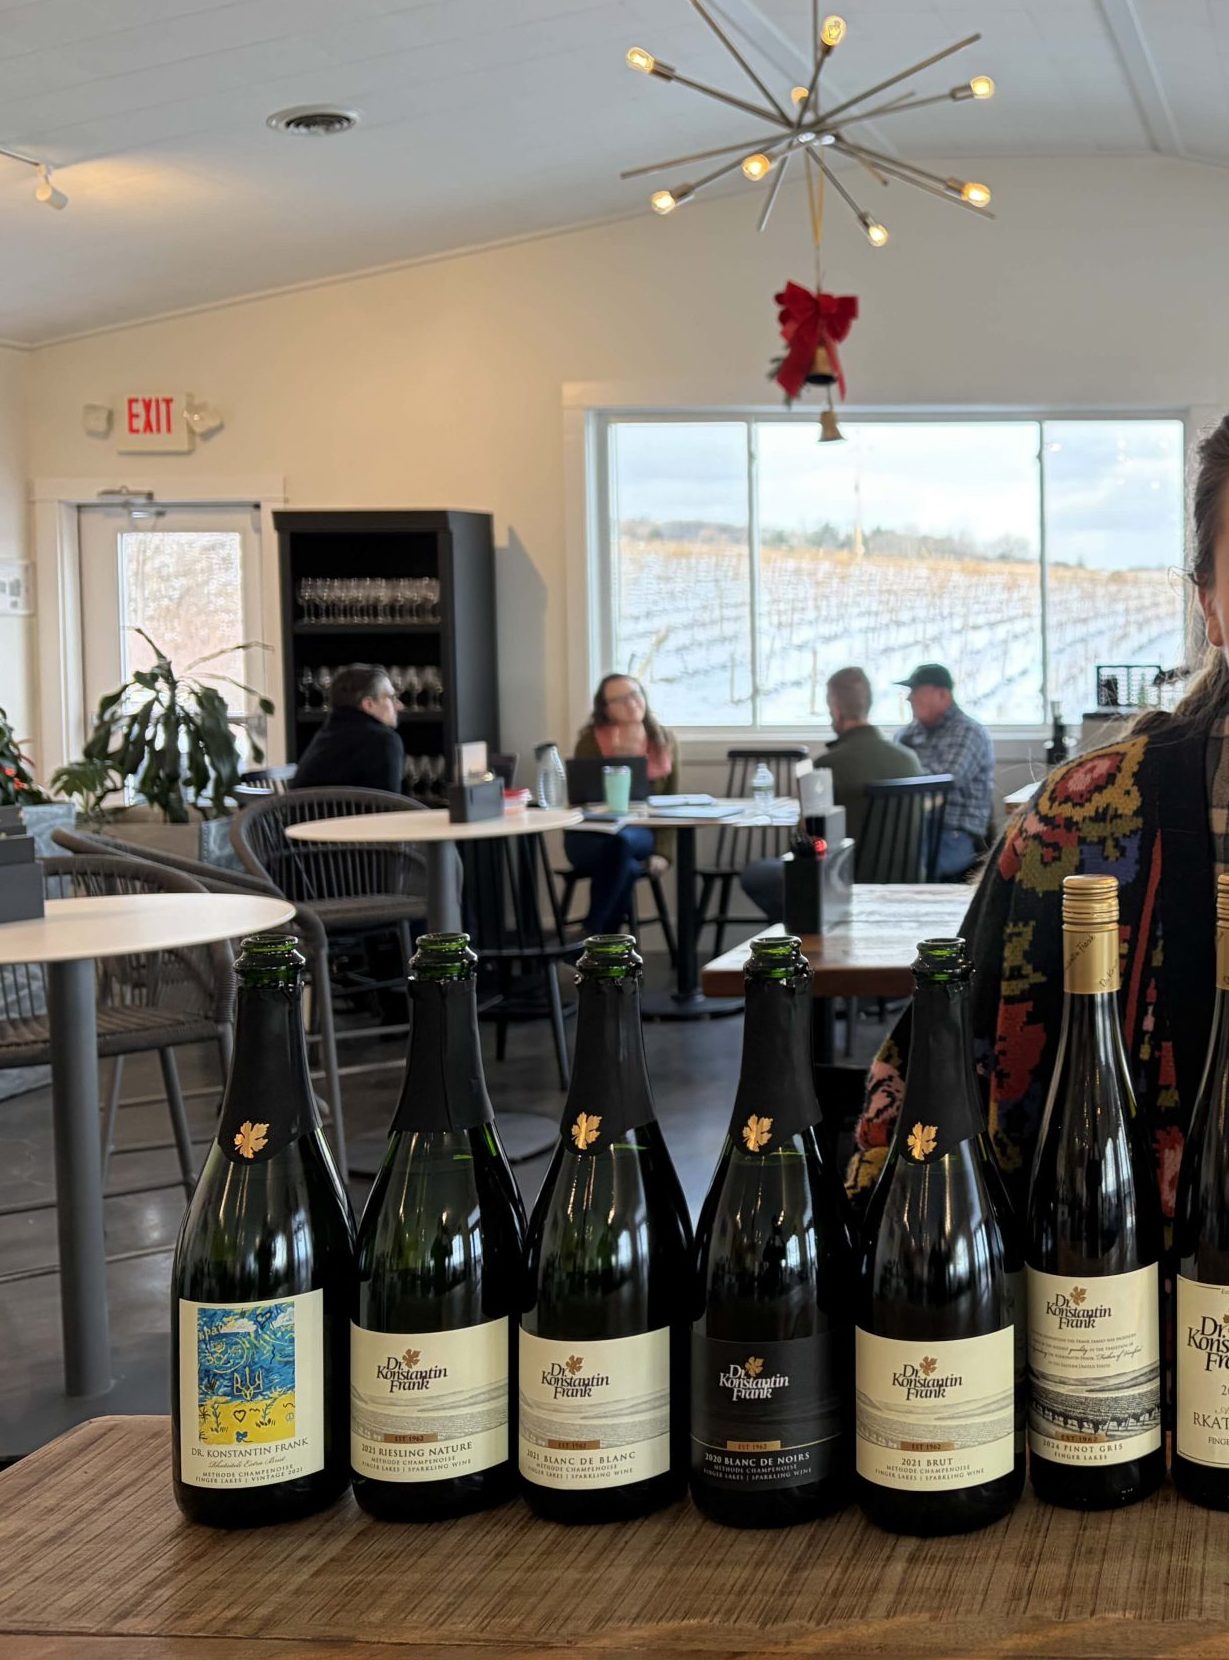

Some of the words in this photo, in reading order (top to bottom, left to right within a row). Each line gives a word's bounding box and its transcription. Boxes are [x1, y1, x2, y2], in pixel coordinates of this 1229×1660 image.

[127, 397, 173, 434] EXIT
[1055, 1293, 1071, 1308] Dr.
[1046, 1301, 1112, 1318] Konstantin
[1058, 1317, 1096, 1330] Frank
[1200, 1315, 1225, 1338] Dr.
[386, 1357, 403, 1370] Dr.
[550, 1362, 567, 1377] Dr.
[376, 1365, 448, 1380] Konstantin
[541, 1371, 610, 1387] Konstantin
[729, 1364, 747, 1379] Dr.
[903, 1364, 920, 1379] Dr.
[389, 1379, 430, 1393] Frank
[719, 1374, 790, 1389] Konstantin
[892, 1373, 963, 1389] Konstantin
[553, 1383, 593, 1400] Frank
[732, 1386, 772, 1402] Frank
[906, 1385, 946, 1401] Frank
[192, 1447, 205, 1456] DR.
[207, 1447, 272, 1458] KONSTANTIN
[275, 1438, 309, 1452] FRANK
[379, 1448, 425, 1458] RIESLING
[429, 1441, 473, 1456] NATURE
[1043, 1440, 1060, 1450] 2024
[1064, 1444, 1094, 1453] PINOT
[1099, 1443, 1123, 1452] GRIS
[402, 1455, 456, 1466] CHAMPENOISE
[544, 1454, 575, 1465] BLANC
[580, 1457, 594, 1465] DE
[599, 1451, 636, 1464] BLANC
[704, 1452, 722, 1464] 2020
[724, 1456, 757, 1467] BLANC
[760, 1458, 773, 1466] DE
[777, 1452, 810, 1465] NOIRS
[901, 1458, 921, 1467] 2021
[926, 1458, 954, 1467] BRUT
[1054, 1452, 1080, 1460] FINGER
[238, 1464, 294, 1477] CHAMPENOISE
[408, 1463, 449, 1473] SPARKLING
[452, 1458, 472, 1467] WINE
[566, 1464, 617, 1472] CHAMPENOISE
[919, 1464, 971, 1474] CHAMPENOISE
[252, 1472, 285, 1482] VINTAGE
[288, 1467, 303, 1475] 2021
[571, 1471, 611, 1480] SPARKLING
[614, 1468, 633, 1476] WINE
[751, 1472, 791, 1481] SPARKLING
[925, 1472, 964, 1481] SPARKLING
